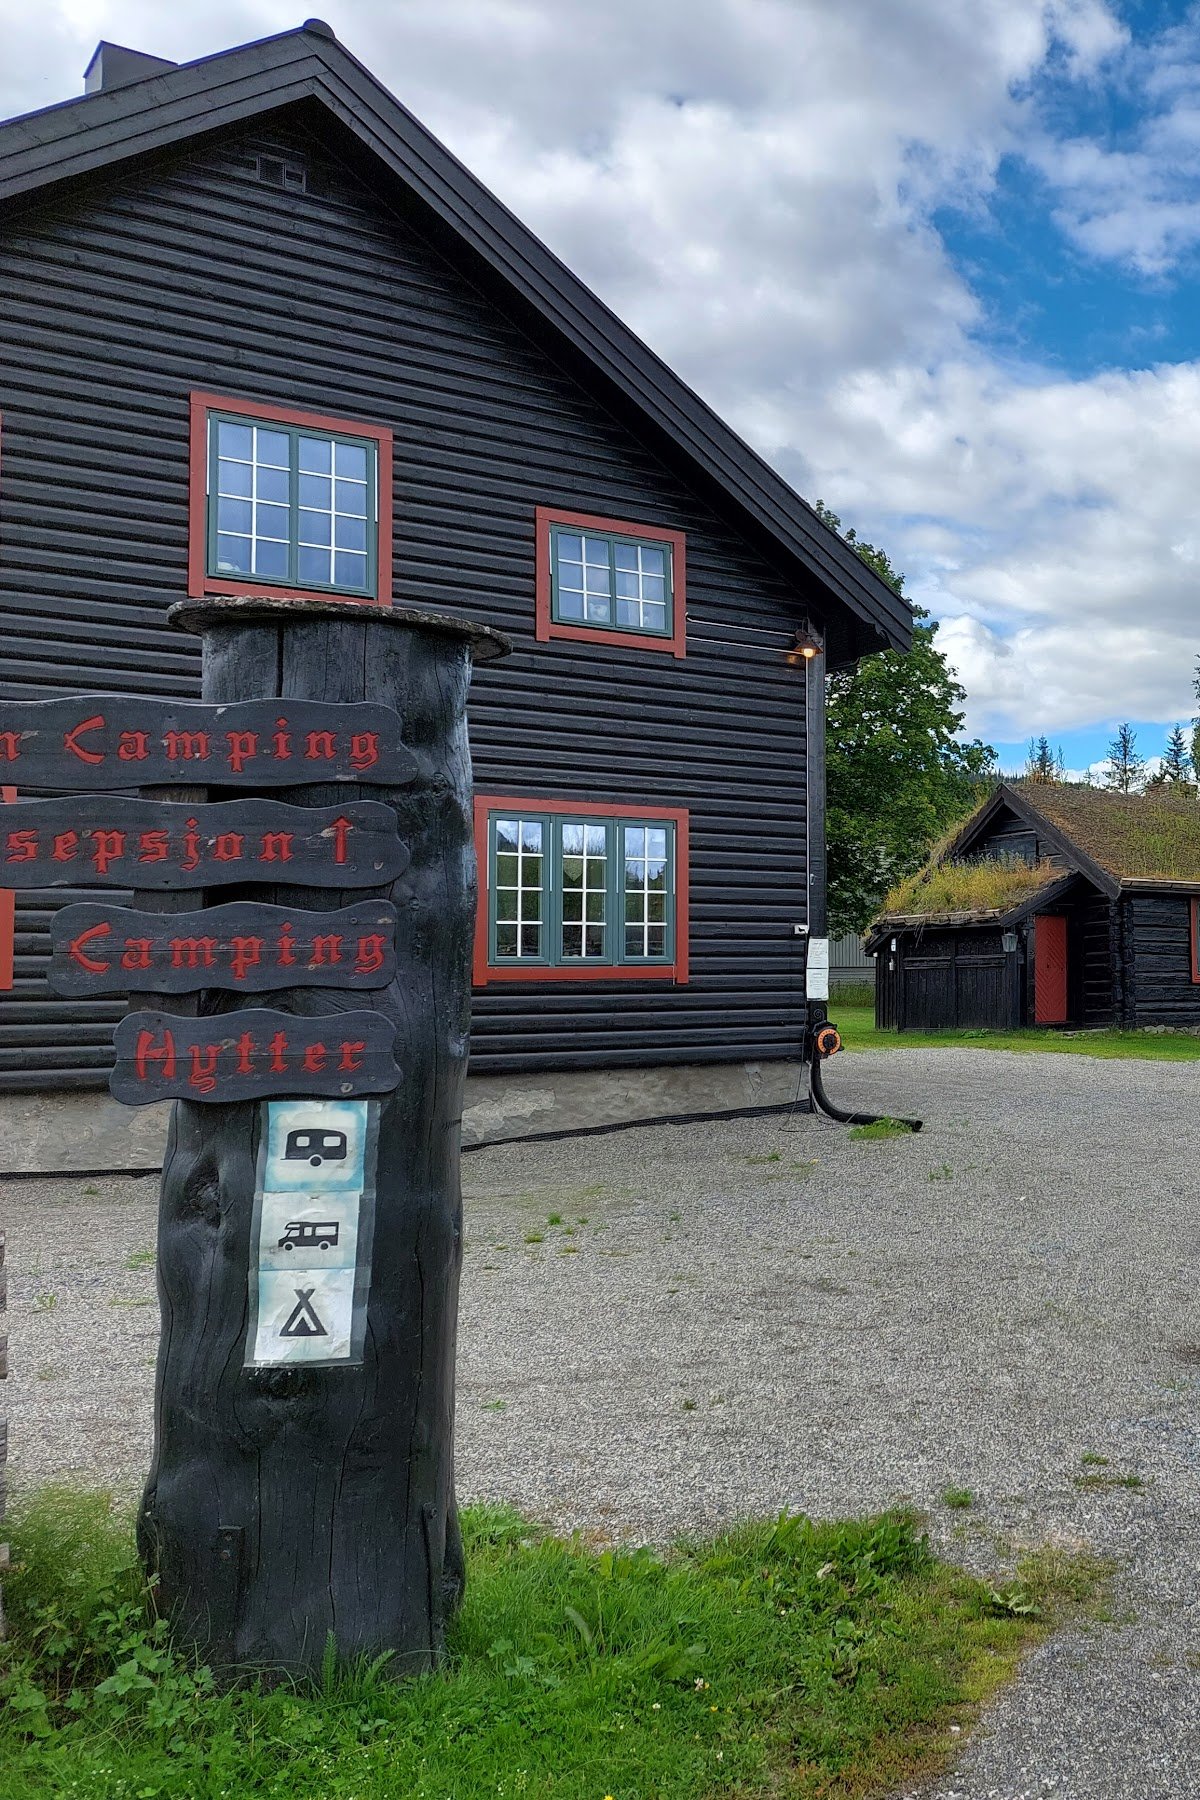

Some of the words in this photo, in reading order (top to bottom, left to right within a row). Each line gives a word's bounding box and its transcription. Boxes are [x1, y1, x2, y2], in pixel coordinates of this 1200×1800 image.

[64, 714, 380, 772] Camping
[6, 818, 294, 874] sepsjon
[69, 922, 387, 980] Camping
[135, 1029, 366, 1093] Hytter
